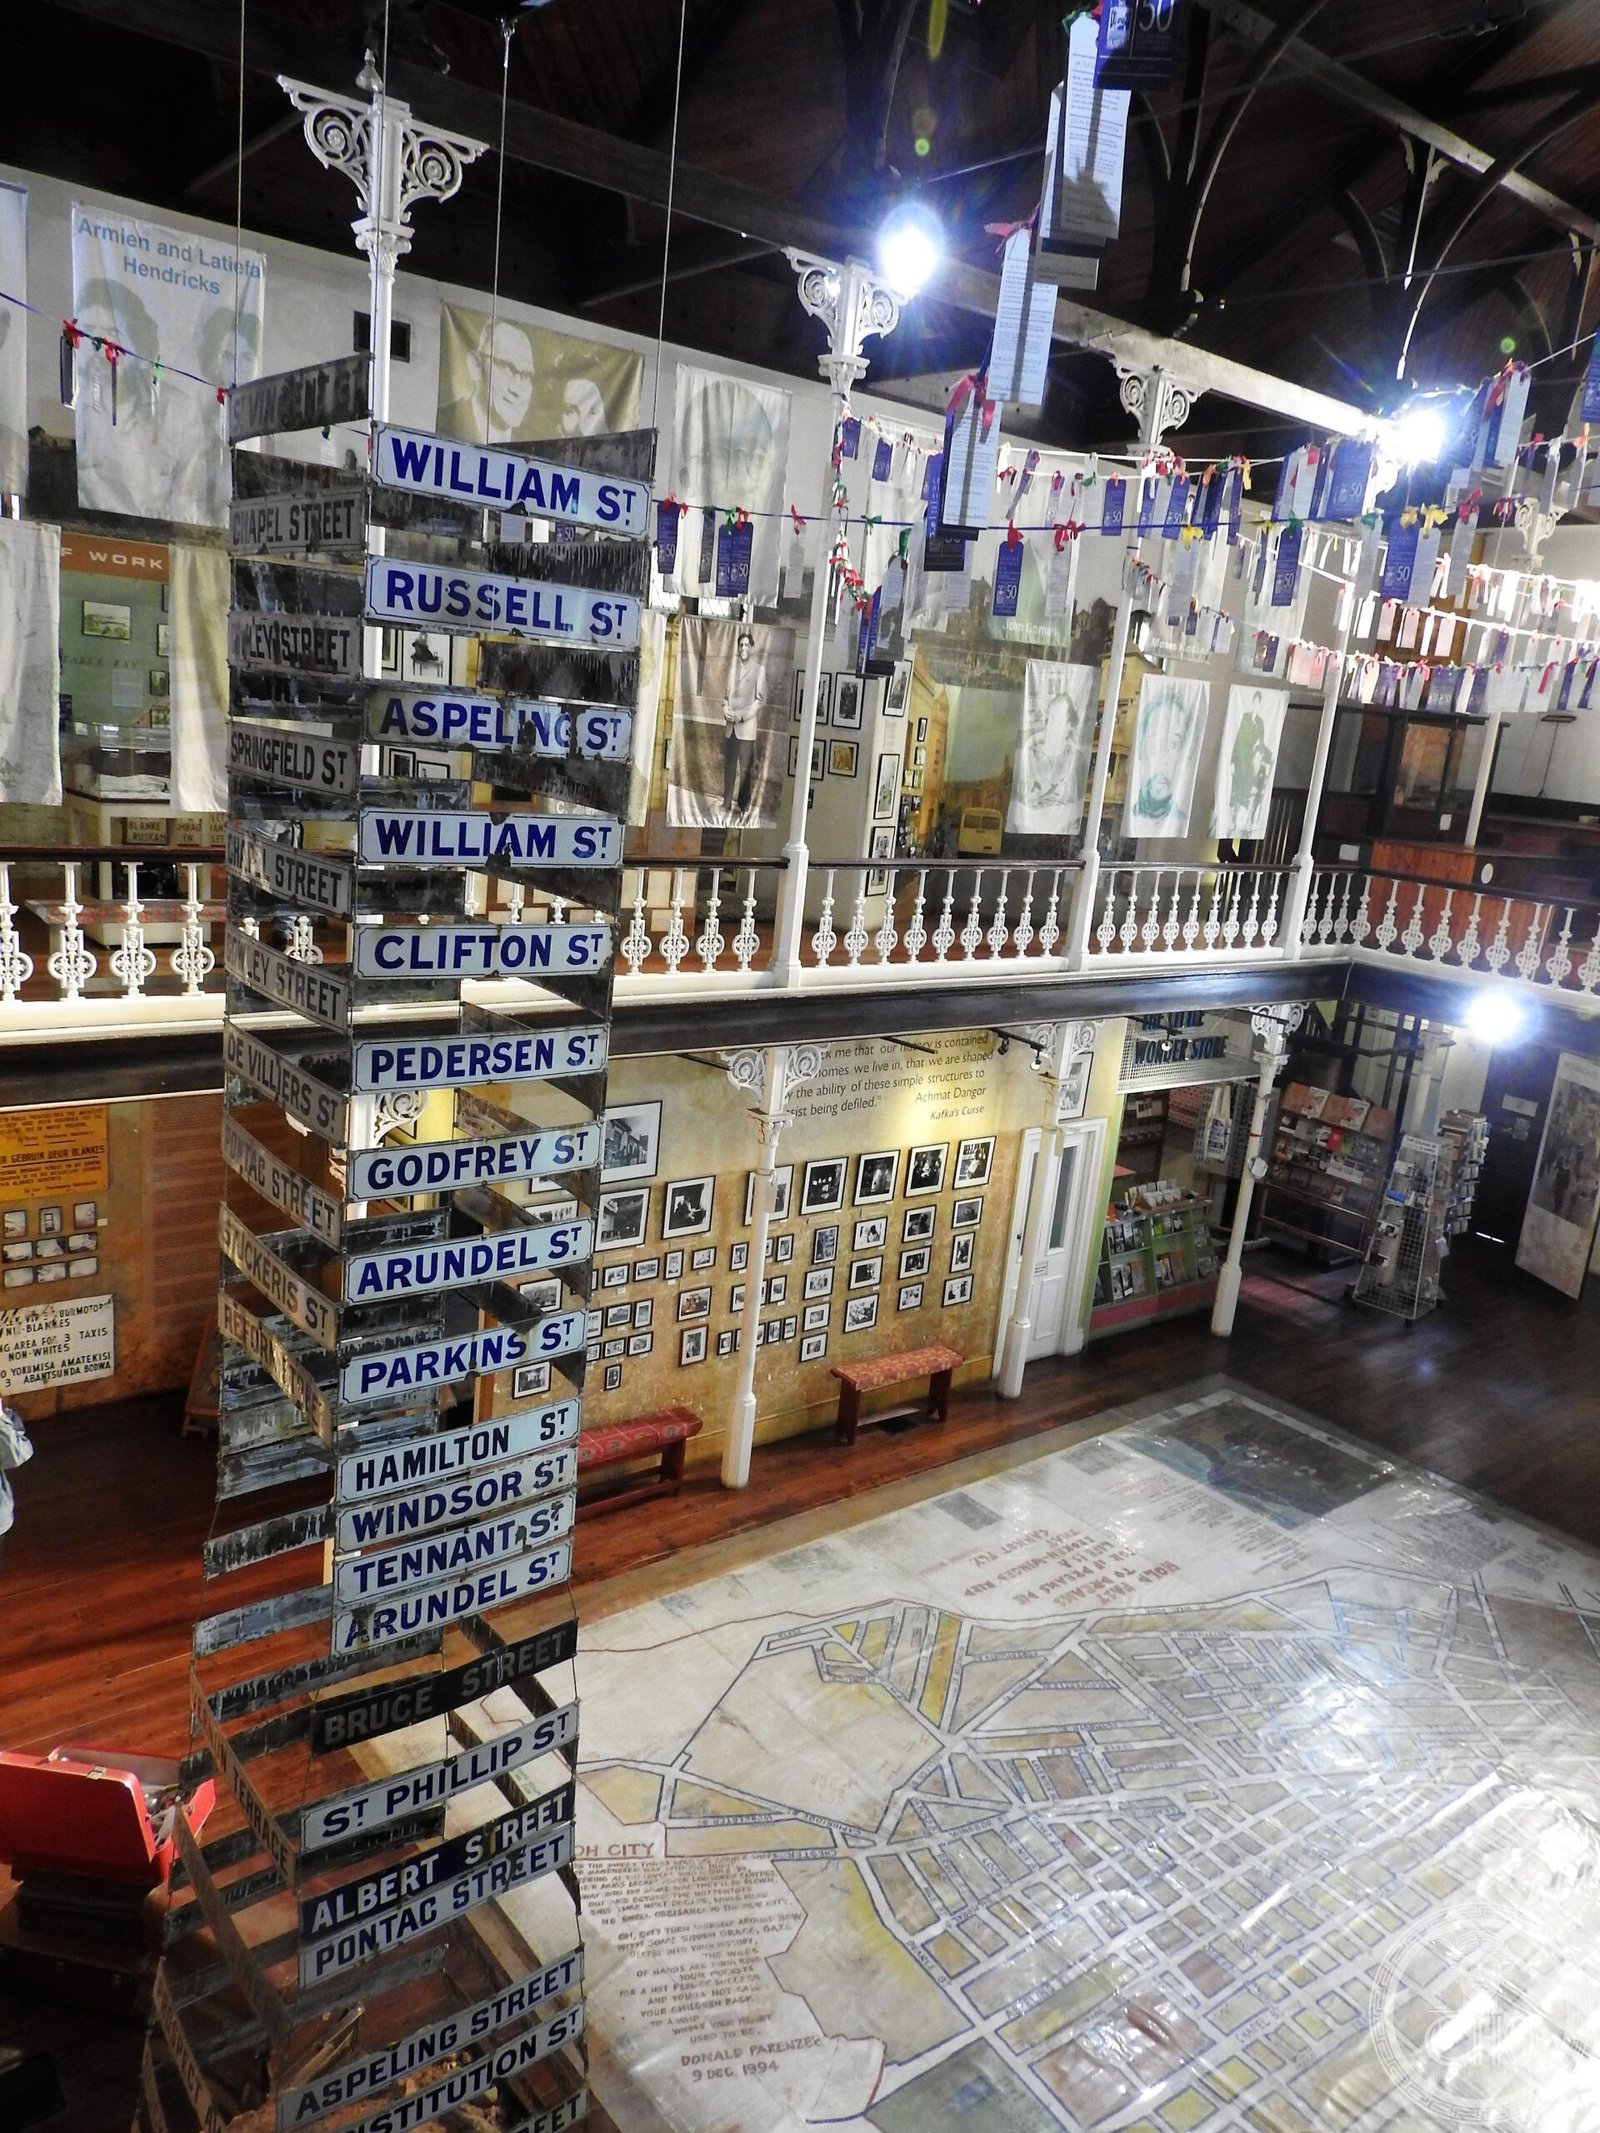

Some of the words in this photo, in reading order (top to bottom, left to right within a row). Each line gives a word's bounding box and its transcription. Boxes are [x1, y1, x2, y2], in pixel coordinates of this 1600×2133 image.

[78, 218, 150, 252] Armien
[158, 239, 192, 263] and
[199, 247, 261, 279] Latiefa
[124, 255, 220, 295] Hendricks
[391, 437, 580, 515] WILLIAM
[232, 506, 284, 546] CHAPEL
[289, 498, 355, 541] STREET
[89, 550, 164, 570] WORK
[387, 570, 573, 633] RUSSELL
[1006, 584, 1018, 600] 50
[281, 624, 350, 668] STREET
[379, 698, 572, 748] ASPELING
[230, 730, 316, 781] SPRINGFIELD
[375, 818, 556, 859] WILLIAM
[275, 853, 343, 908] STREET
[374, 933, 552, 970] CLIFTON
[276, 961, 341, 1021] STREET
[371, 1038, 555, 1084] PEDERSEN
[834, 1048, 852, 1058] me
[854, 1045, 874, 1056] that
[880, 1044, 897, 1054] our
[935, 1038, 942, 1049] is
[944, 1034, 989, 1049] contained
[854, 1064, 870, 1074] we
[872, 1060, 889, 1072] live
[906, 1057, 925, 1070] that
[929, 1057, 943, 1066] we
[945, 1054, 961, 1065] are
[962, 1049, 994, 1064] shaped
[227, 1035, 243, 1068] DE
[248, 1044, 312, 1116] VILLIERS
[796, 1086, 814, 1098] the
[816, 1082, 847, 1097] ability
[851, 1079, 863, 1092] of
[864, 1077, 891, 1091] these
[893, 1074, 924, 1090] simple
[927, 1070, 973, 1085] structures
[975, 1069, 985, 1079] to
[810, 1102, 838, 1118] being
[915, 1090, 951, 1105] Achmat
[953, 1085, 987, 1102] Dangor
[930, 1107, 960, 1120] Kafka's
[961, 1104, 985, 1117] Curse
[71, 1144, 105, 1157] BLANKES
[367, 1138, 542, 1191] GODFREY
[271, 1166, 336, 1238] STREET
[222, 1222, 299, 1314] STUCKERIS
[356, 1236, 538, 1296] ARUNDEL
[8, 1343, 71, 1361] NON-WHITES
[11, 1361, 56, 1377] YOKUMISA
[60, 1351, 111, 1368] AMATEKISI
[14, 1339, 37, 1351] AREA
[64, 1333, 71, 1343] 3
[79, 1327, 108, 1340] TAXIS
[360, 1331, 527, 1394] PARKINS
[5, 1378, 12, 1388] 3
[23, 1366, 81, 1385] ABANTSUNDA
[83, 1361, 111, 1374] BODWA
[356, 1424, 510, 1492] HAMILTON
[351, 1470, 523, 1543] WINDSOR
[353, 1519, 516, 1593] TENNANT
[344, 1569, 518, 1648] ARUNDEL
[324, 1677, 433, 1746] BRUCE
[460, 1629, 566, 1698] STREET
[386, 1736, 523, 1817] PHILLIP
[310, 1852, 440, 1934] ALBERT
[464, 1790, 569, 1866] STREET
[607, 1842, 655, 1857] CITY
[315, 1895, 438, 1977] PONTAC
[452, 1833, 566, 1911] STREET
[294, 2021, 459, 2123] ASPELING
[470, 1956, 577, 2038] STREET
[680, 2047, 744, 2067] DONALD
[692, 2068, 702, 2082] 9
[742, 2060, 780, 2077] 1994
